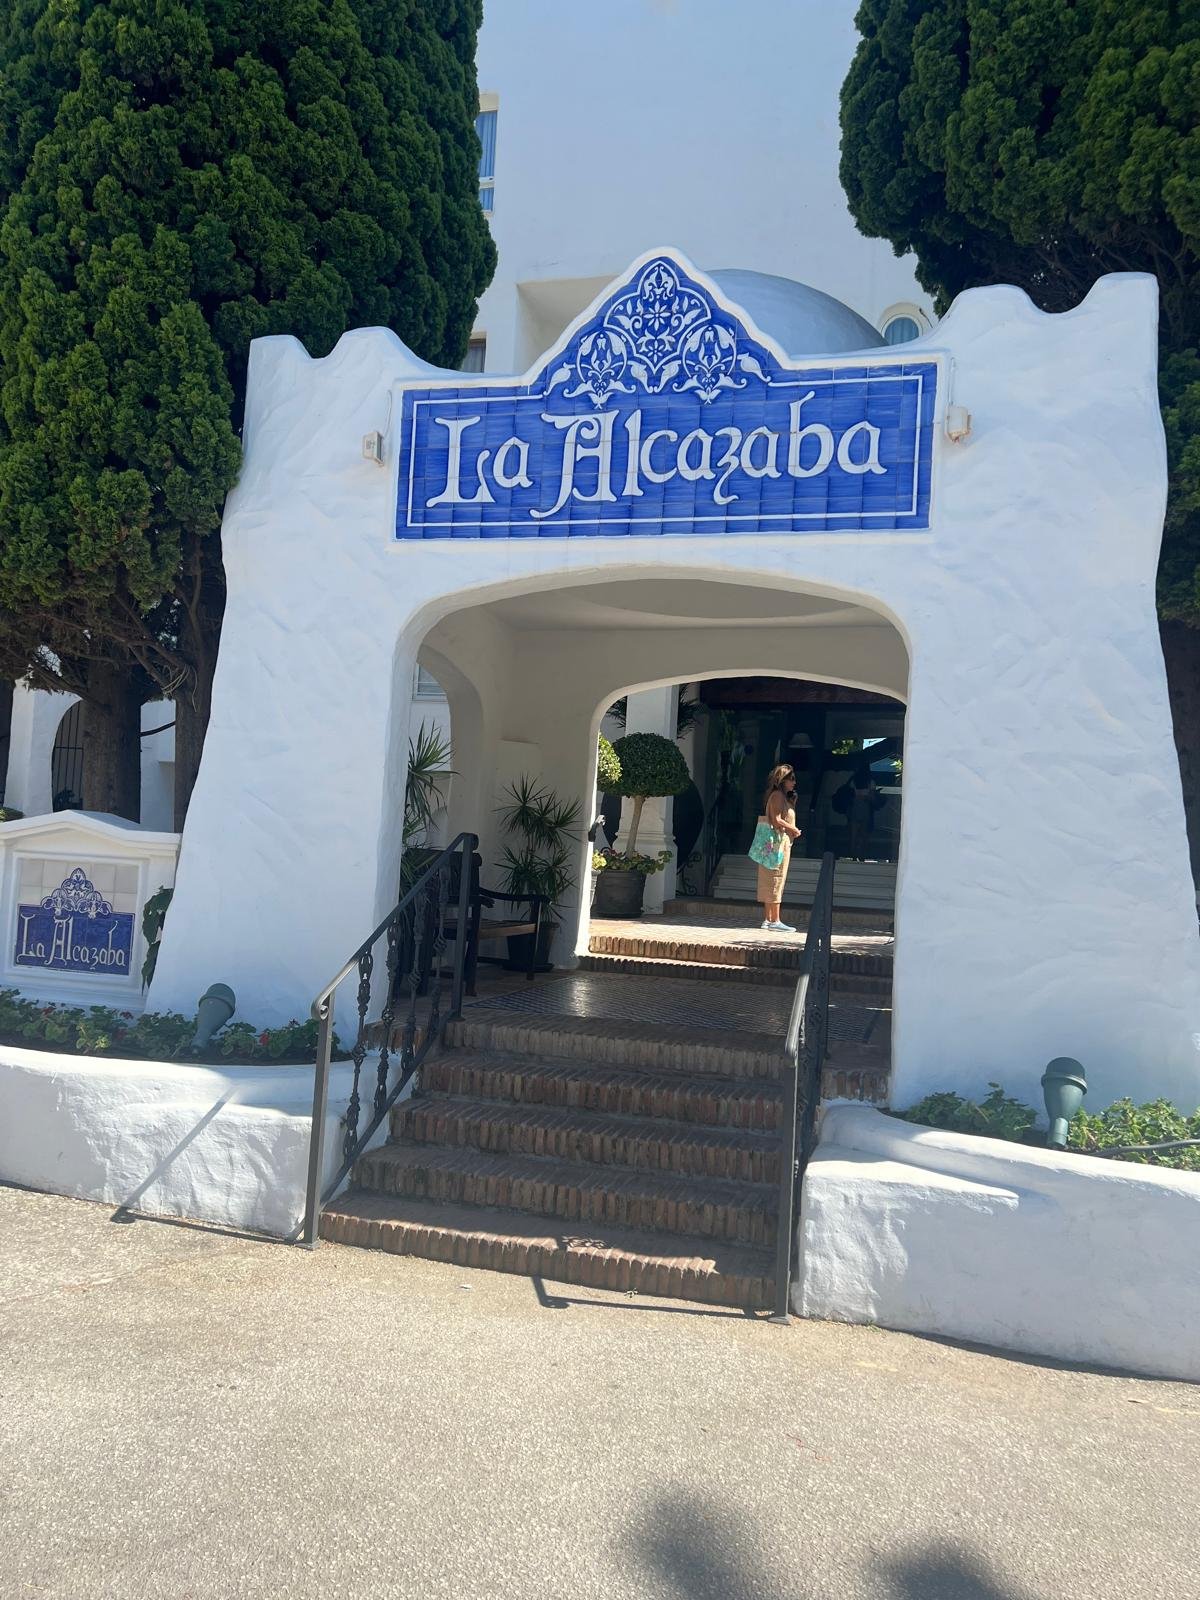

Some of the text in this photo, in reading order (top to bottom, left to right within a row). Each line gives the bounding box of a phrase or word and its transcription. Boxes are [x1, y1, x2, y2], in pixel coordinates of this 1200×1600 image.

[426, 390, 888, 518] La Alcazaba
[17, 913, 126, 971] La Alcazaba
